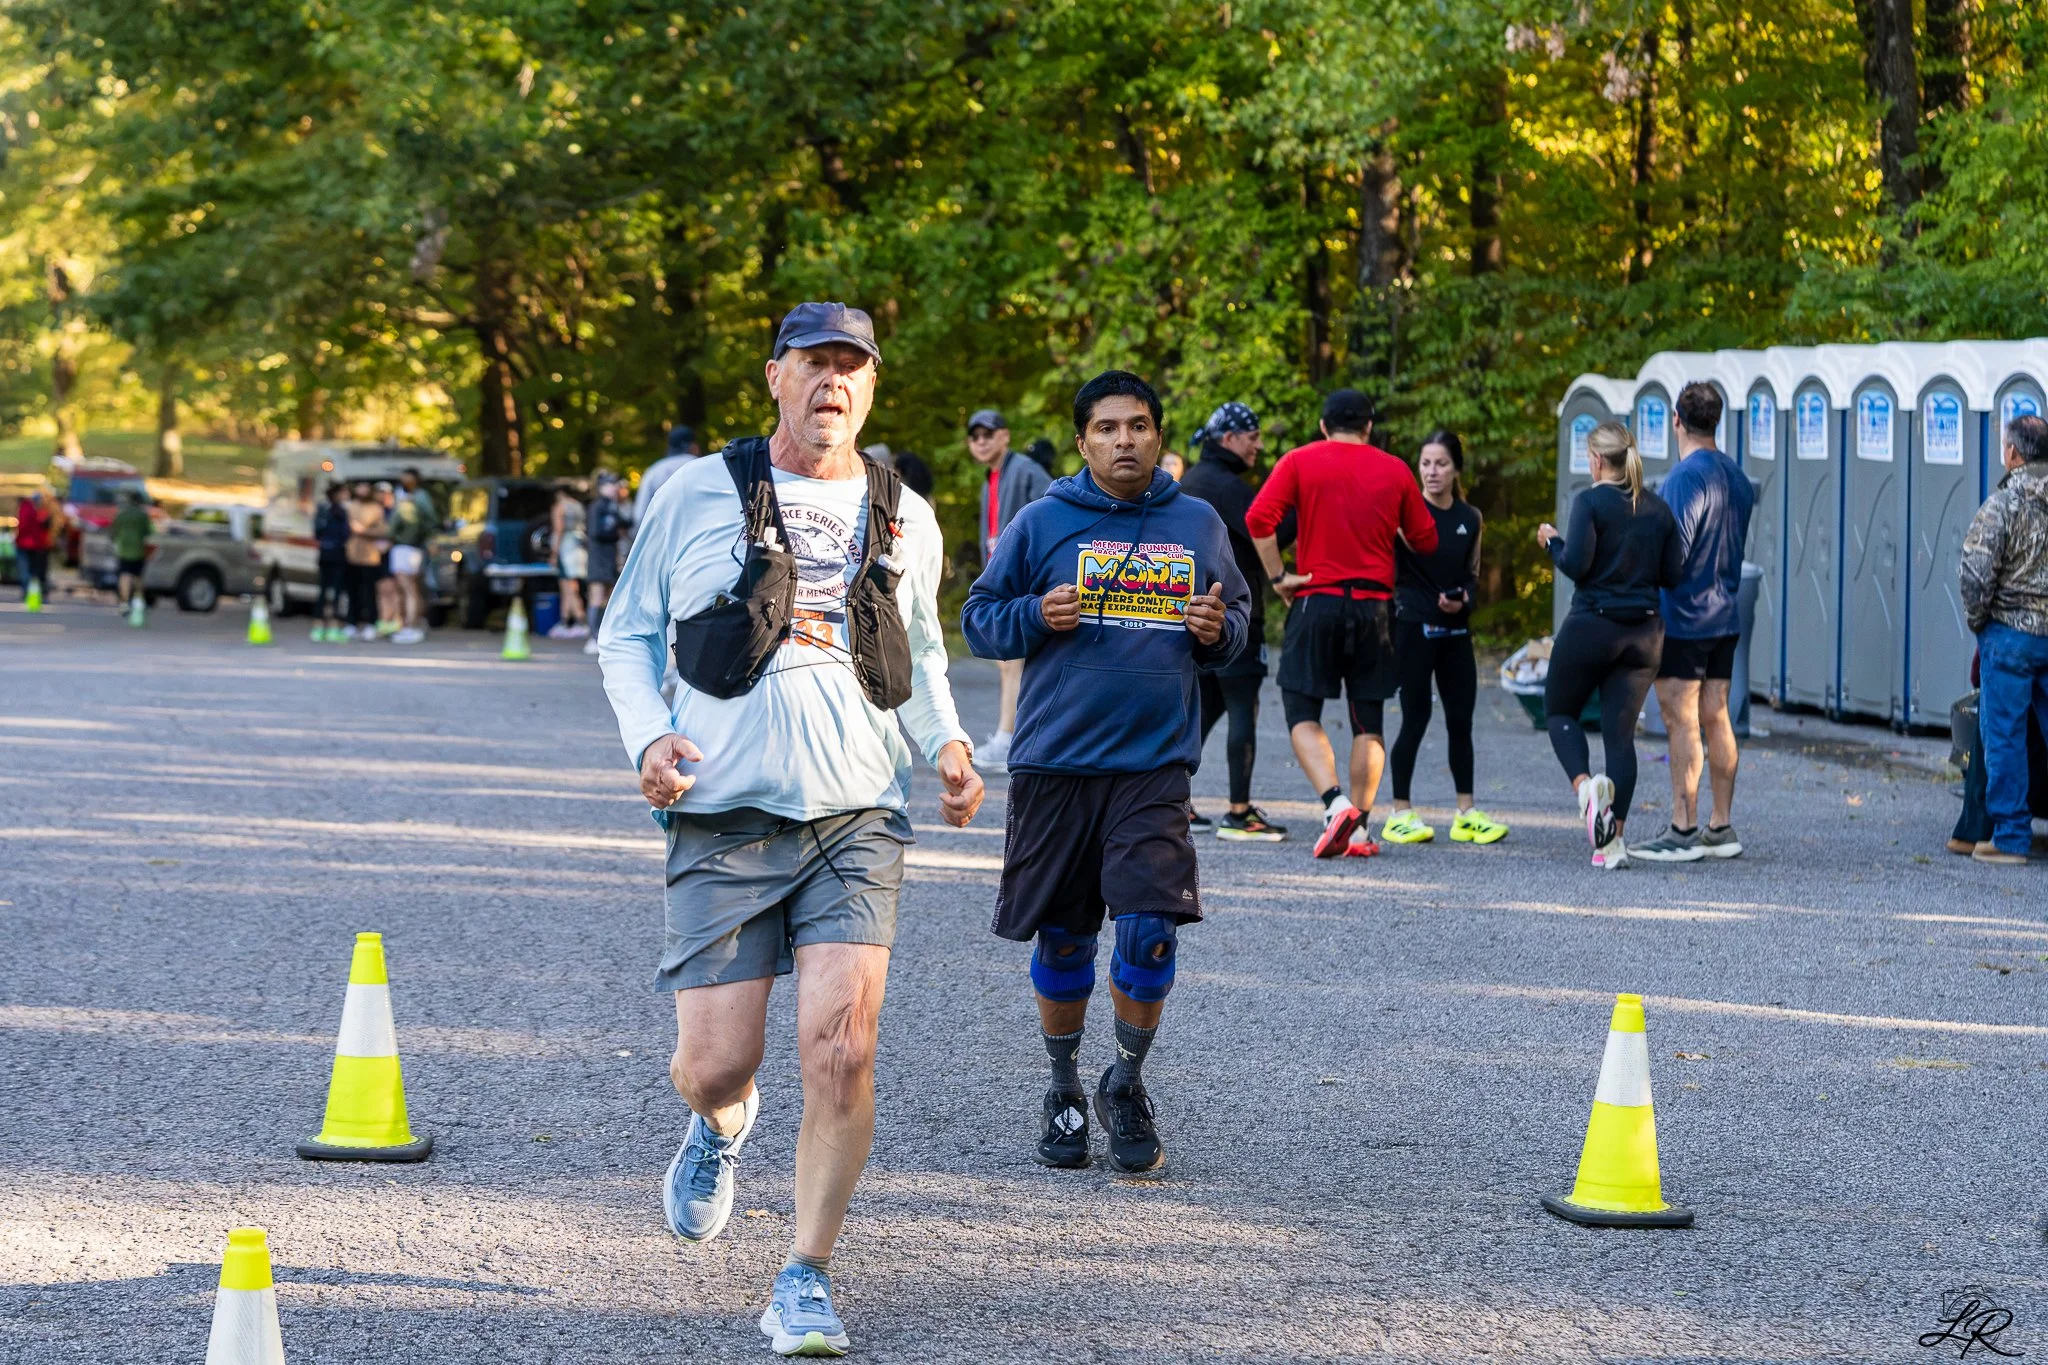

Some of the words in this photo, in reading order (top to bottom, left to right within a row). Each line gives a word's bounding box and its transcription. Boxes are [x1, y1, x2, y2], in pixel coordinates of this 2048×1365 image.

[806, 511, 844, 536] SERIES
[1093, 541, 1137, 552] MEMPH
[1140, 544, 1184, 553] RUNNERS
[1083, 556, 1191, 597] MORE
[806, 581, 849, 597] MEMORIAL
[1108, 603, 1163, 614] EXPERIENCE
[1137, 597, 1166, 606] ONLY
[1165, 599, 1187, 615] 5K
[781, 620, 834, 649] 33
